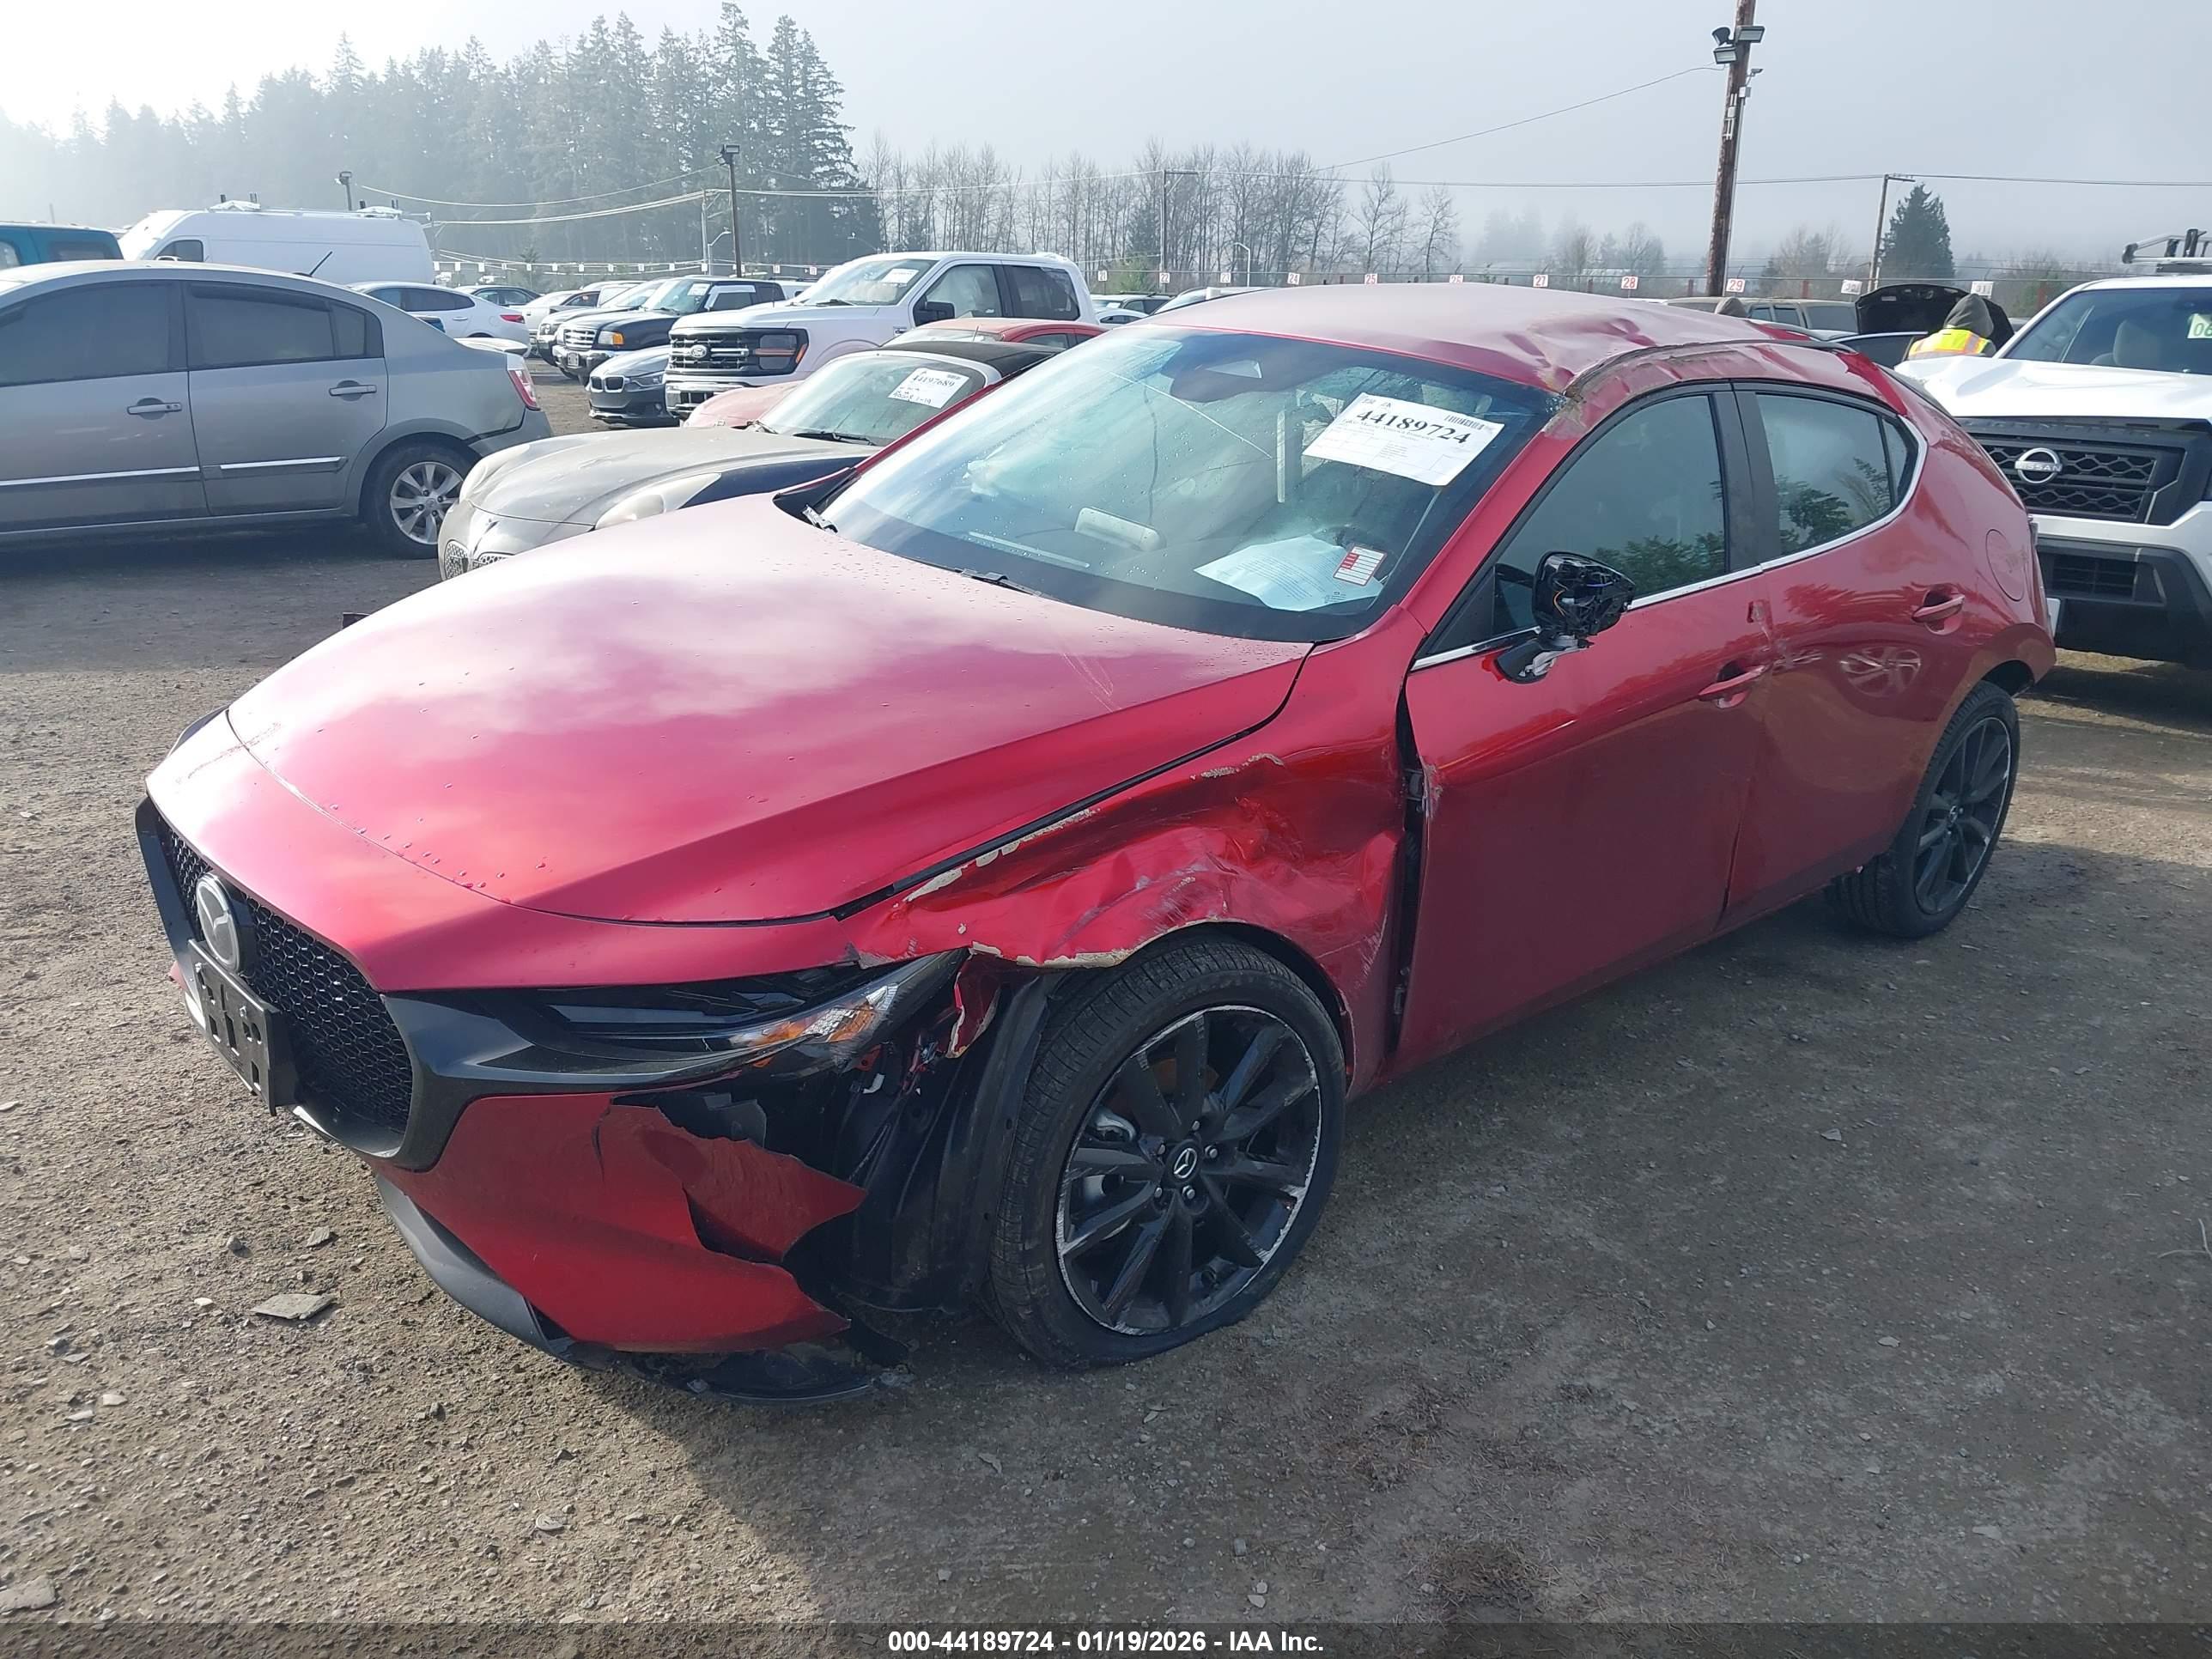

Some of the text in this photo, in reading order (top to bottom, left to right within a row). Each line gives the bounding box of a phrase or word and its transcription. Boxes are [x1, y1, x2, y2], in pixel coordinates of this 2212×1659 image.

[1161, 273, 1170, 283] 22
[1289, 274, 1298, 284] 24
[1365, 274, 1376, 284] 25
[1534, 275, 1547, 286] 27
[1623, 277, 1636, 289] 28
[1729, 279, 1743, 291] 29
[1357, 410, 1472, 444] 44189724
